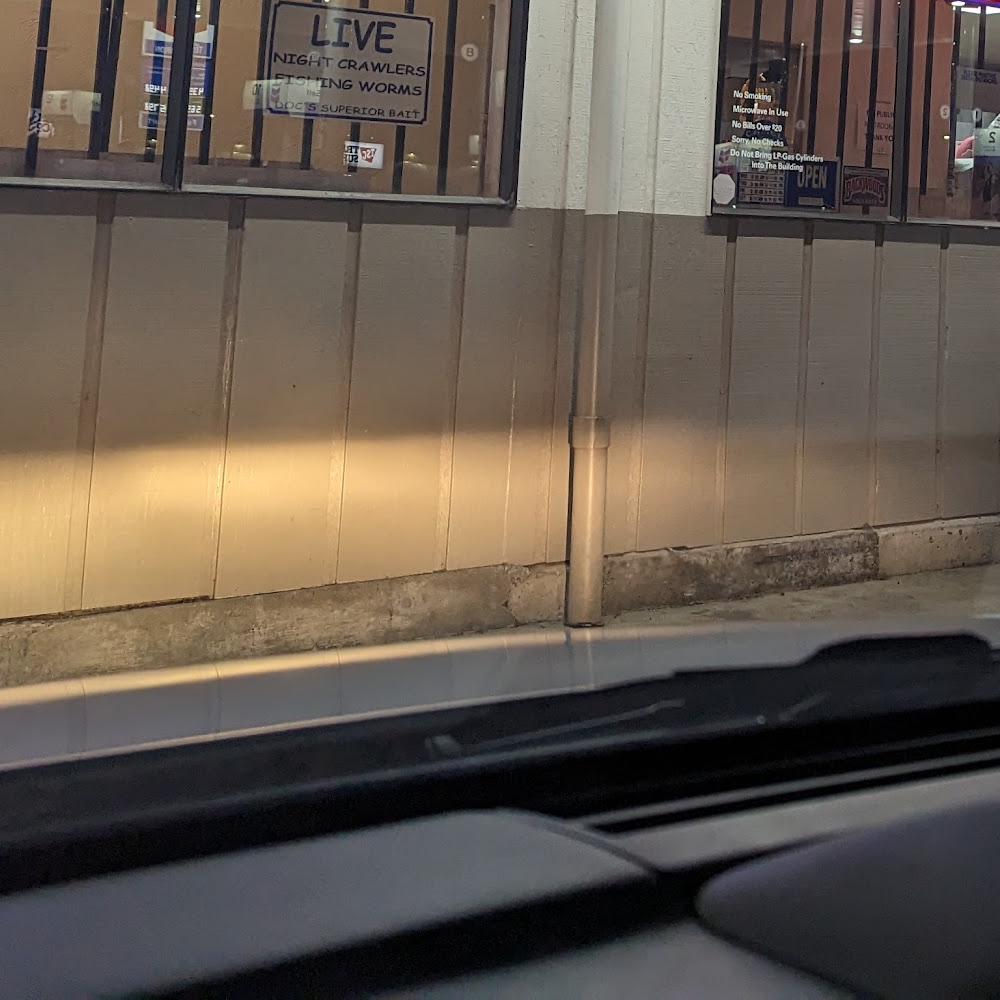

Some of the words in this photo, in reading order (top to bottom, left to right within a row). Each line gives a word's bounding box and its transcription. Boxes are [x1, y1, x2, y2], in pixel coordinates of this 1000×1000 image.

[311, 14, 396, 54] LIVE
[273, 52, 334, 68] NIGHT
[337, 59, 425, 77] CRAWLERS
[275, 73, 353, 90] FISHING
[359, 81, 422, 96] WORMS
[733, 90, 743, 98] No
[744, 91, 771, 102] Smoking
[275, 101, 317, 111] DOC'S
[321, 104, 385, 117] SUPERIOR
[389, 109, 421, 119] BAIT
[732, 105, 767, 115] Microwave
[768, 108, 775, 116] In
[776, 109, 789, 117] Use
[731, 120, 741, 128] No
[742, 121, 755, 130] Bills
[756, 122, 771, 131] Over
[772, 124, 782, 132] $20
[751, 137, 761, 145] No
[762, 138, 784, 147] Checks
[730, 149, 739, 157] Do
[741, 150, 753, 158] Not
[755, 150, 772, 160] Bring
[773, 152, 794, 160] LP-Gas
[796, 153, 823, 162] Cylinders
[751, 161, 765, 169] Into
[778, 163, 804, 172] Building
[797, 163, 827, 189] OPEN
